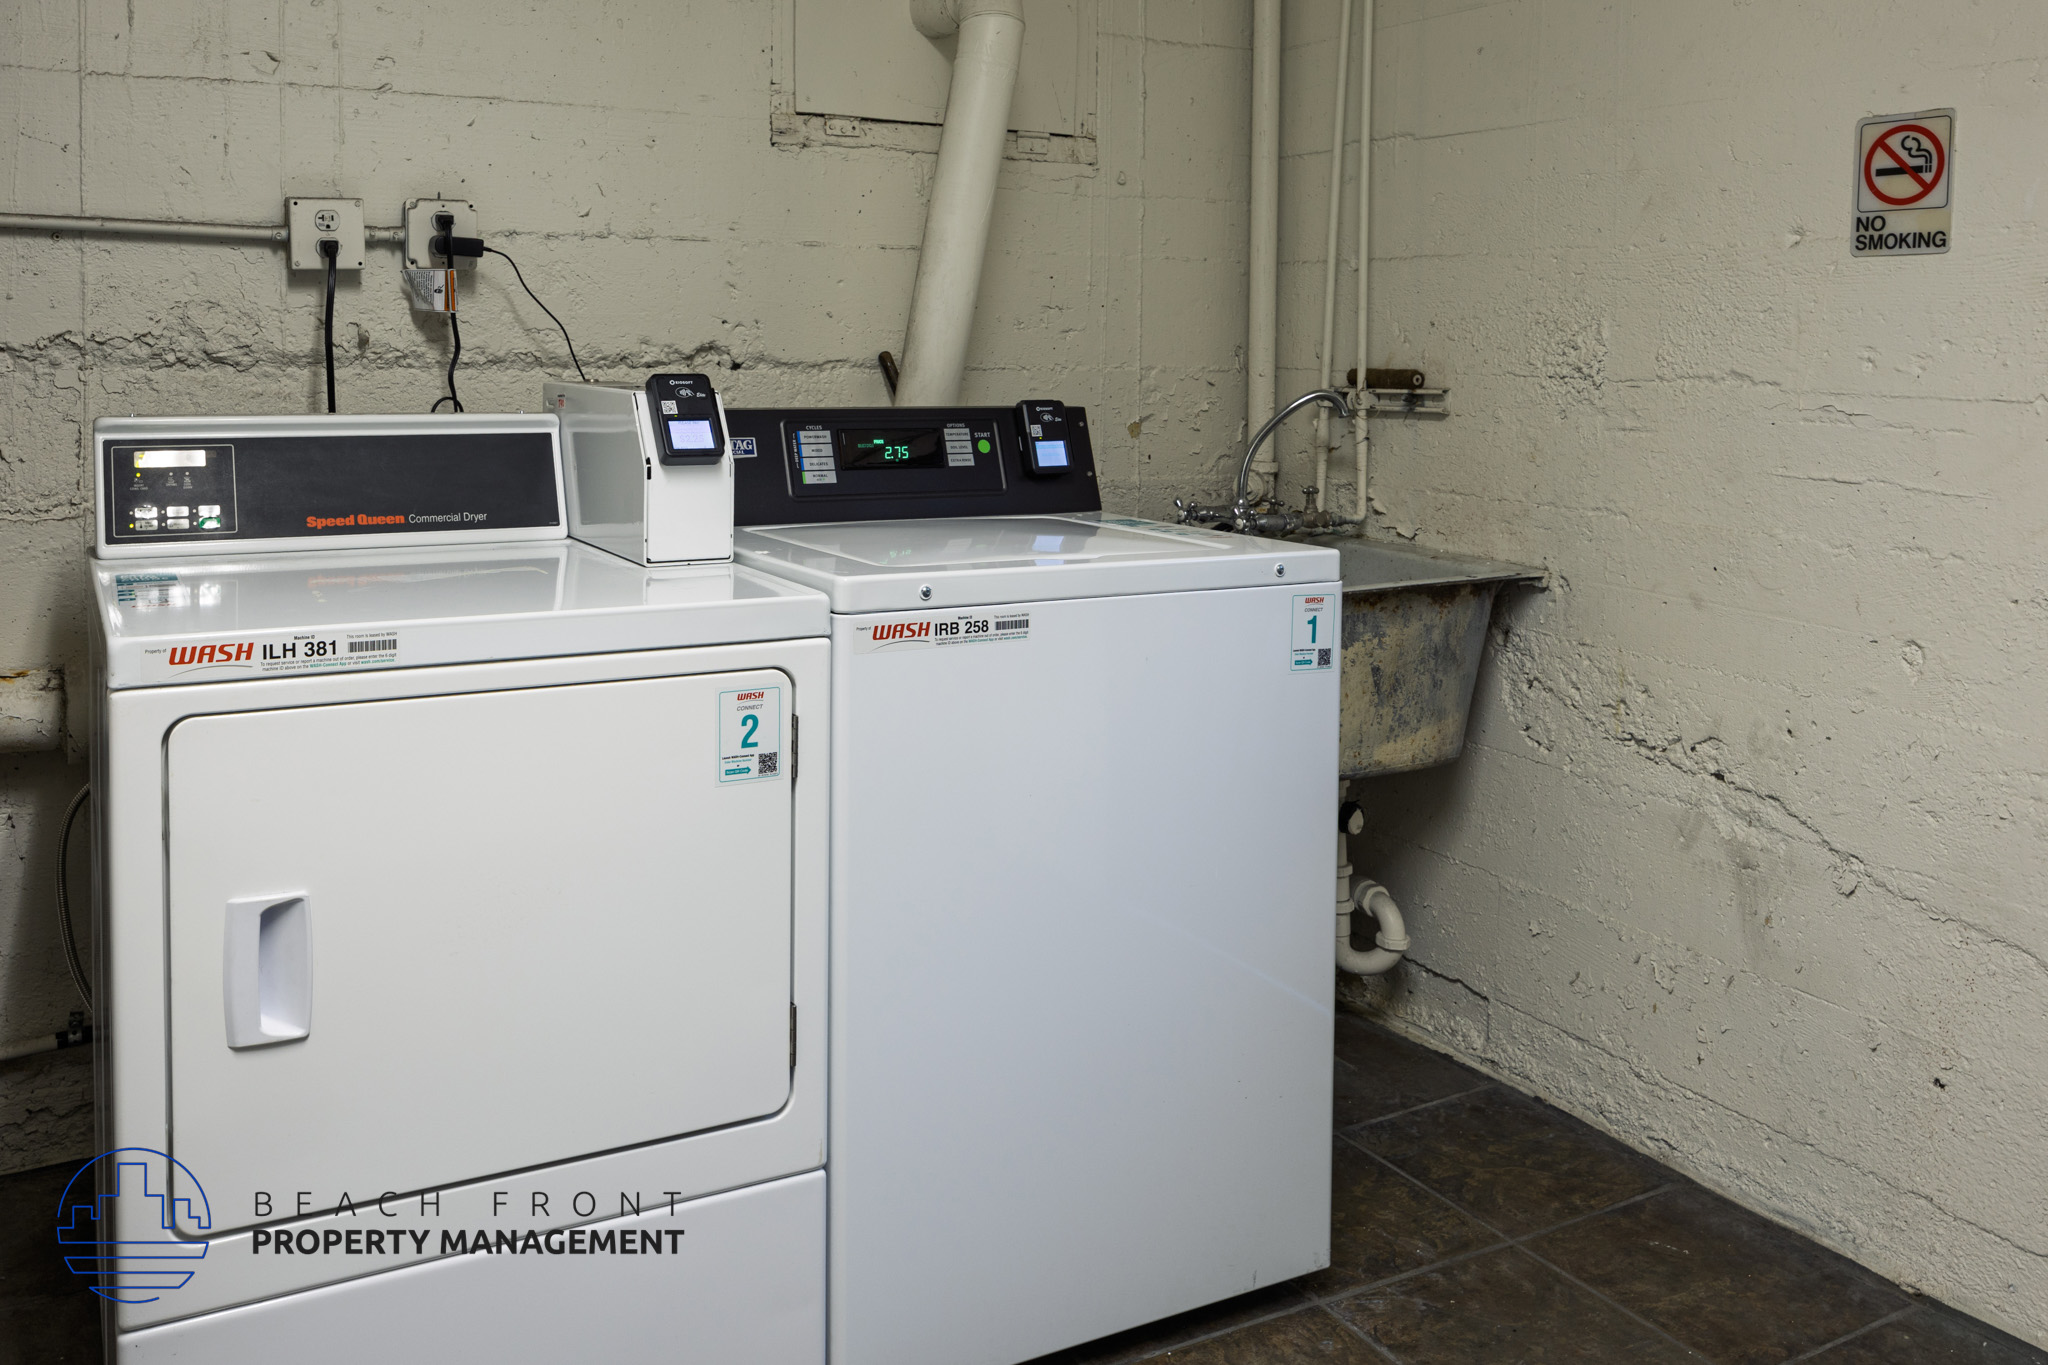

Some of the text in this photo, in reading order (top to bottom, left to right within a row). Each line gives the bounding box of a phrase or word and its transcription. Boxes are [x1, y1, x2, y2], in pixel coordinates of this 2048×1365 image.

[1856, 215, 1886, 232] NO
[1855, 230, 1947, 251] SMOKING
[884, 446, 909, 459] 2.75
[306, 512, 487, 529] Speed Queen Commercial Dryer
[872, 622, 931, 640] WASH
[935, 620, 989, 636] IRB 258
[1307, 615, 1317, 643] 1
[169, 642, 254, 665] WASH
[263, 640, 336, 660] ILH 381
[737, 692, 764, 701] WASH
[741, 714, 759, 749] 2
